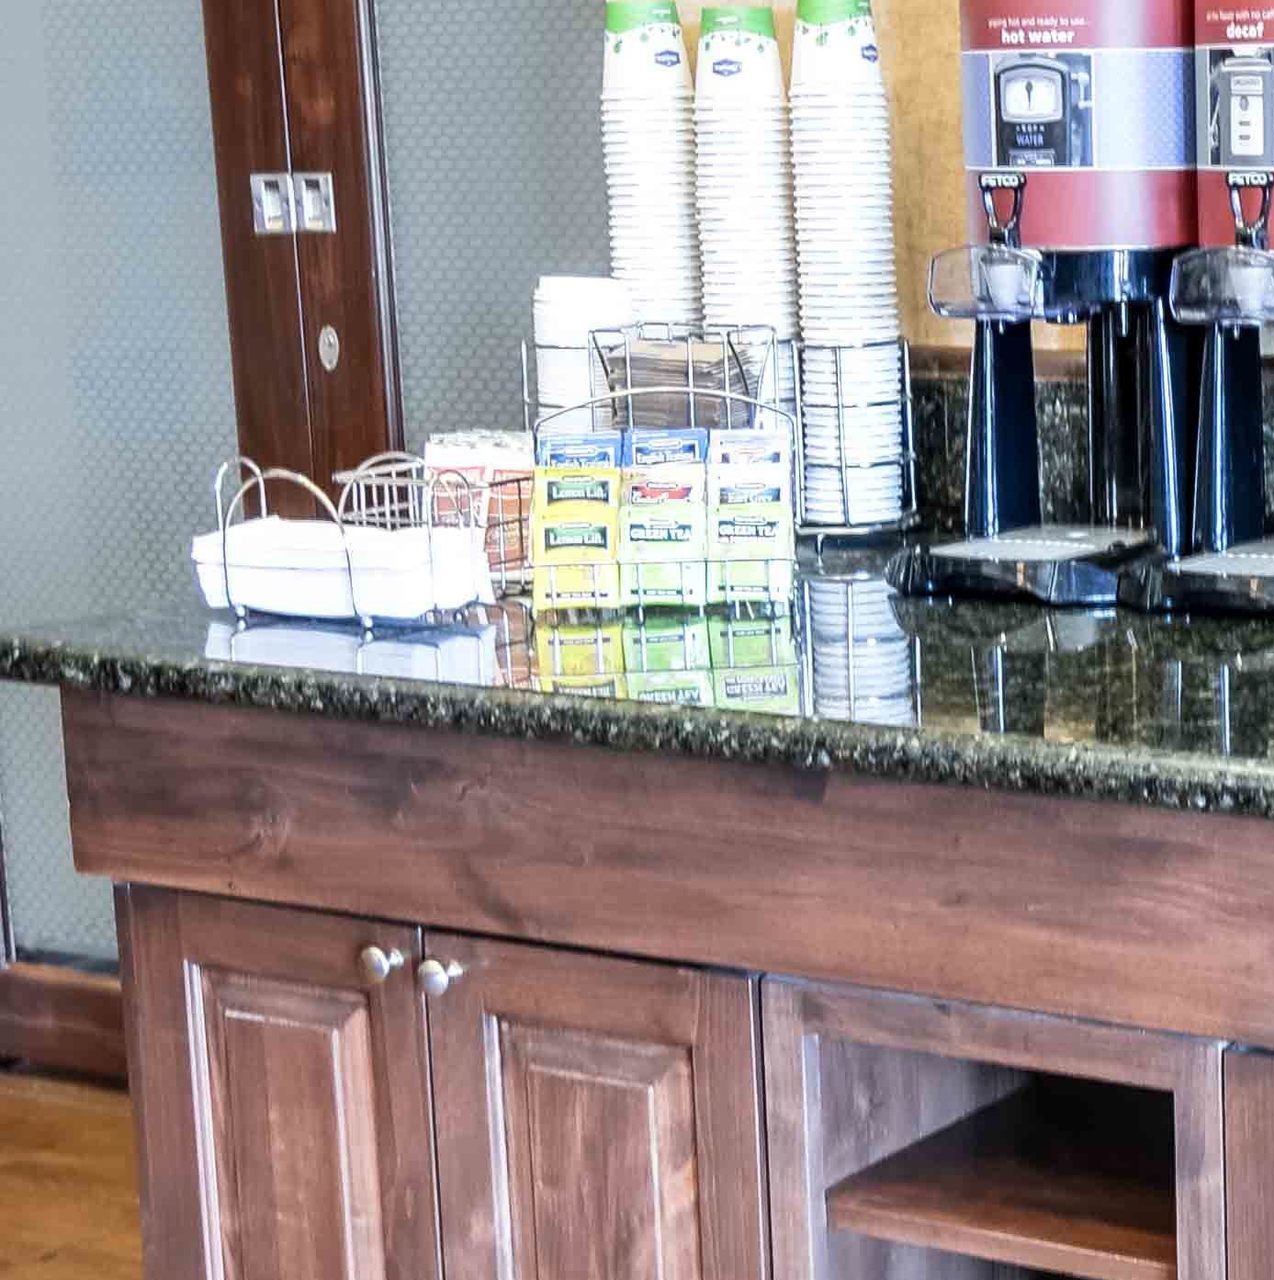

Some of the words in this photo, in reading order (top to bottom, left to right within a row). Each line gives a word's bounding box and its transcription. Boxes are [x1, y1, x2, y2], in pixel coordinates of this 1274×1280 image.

[1001, 28, 1025, 44] hot
[1028, 29, 1076, 44] water
[1226, 21, 1265, 39] decaf
[1015, 132, 1044, 147] WATER
[981, 174, 1019, 188] FETCO
[1228, 172, 1268, 186] FETCO
[552, 485, 585, 500] Lemon
[629, 525, 667, 541] GREEN
[670, 525, 692, 541] TEA
[719, 524, 755, 538] GREEN
[757, 523, 777, 538] TEA
[549, 531, 583, 546] Lemon
